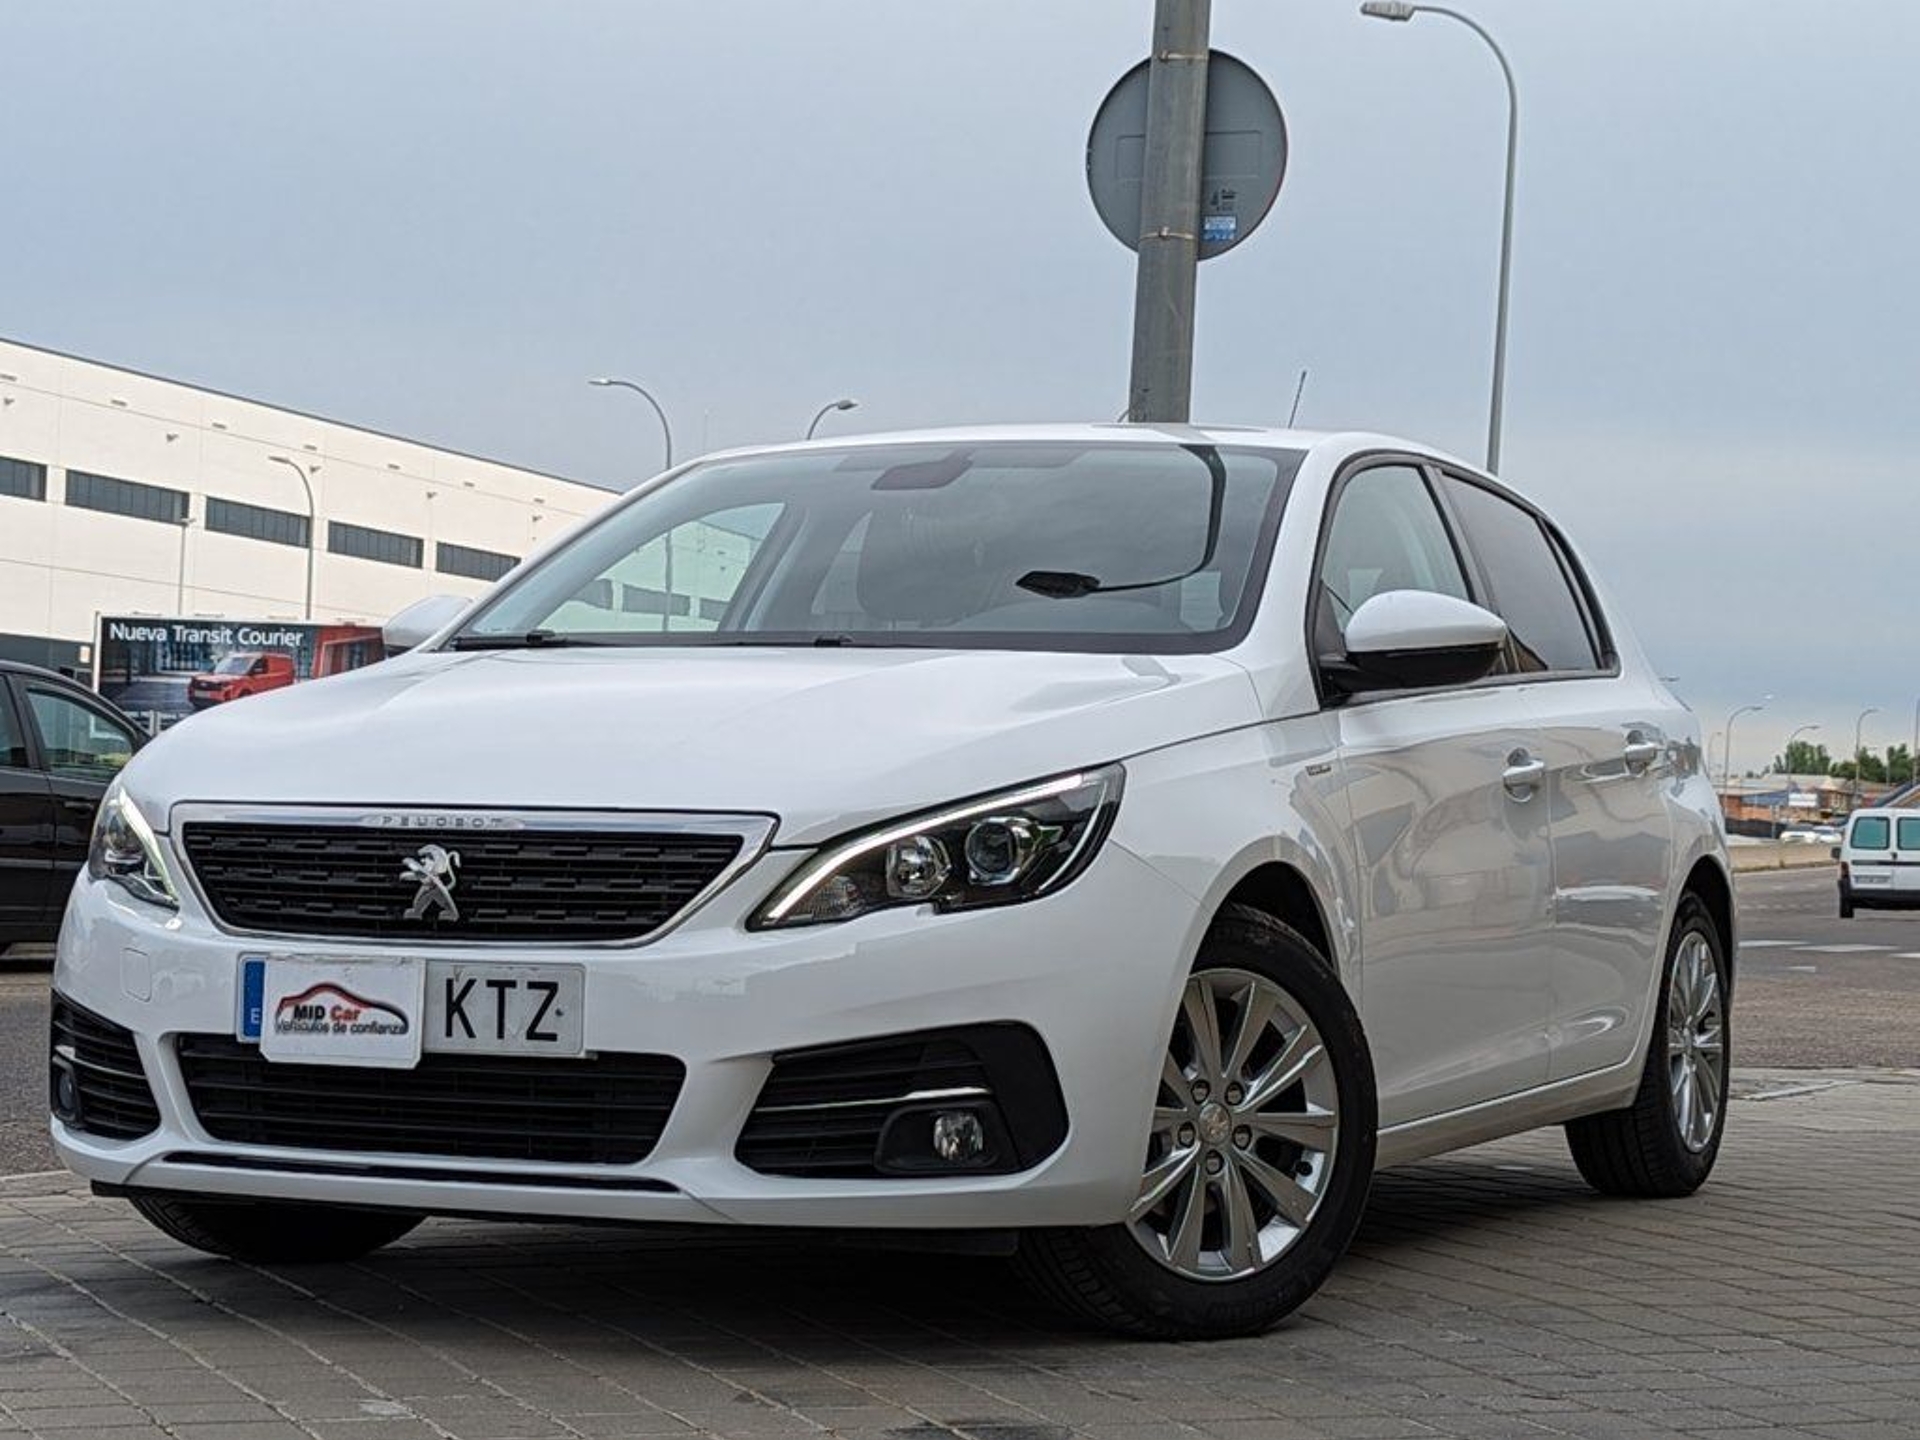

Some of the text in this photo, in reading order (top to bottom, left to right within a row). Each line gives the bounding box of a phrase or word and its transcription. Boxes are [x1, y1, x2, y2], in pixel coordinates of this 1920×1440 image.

[109, 623, 304, 647] Nueva Transit Courier
[250, 1008, 260, 1024] E
[293, 1004, 361, 1021] MID Car
[444, 977, 560, 1042] KTZ
[332, 1020, 347, 1034] de
[350, 1020, 407, 1036] confianza
